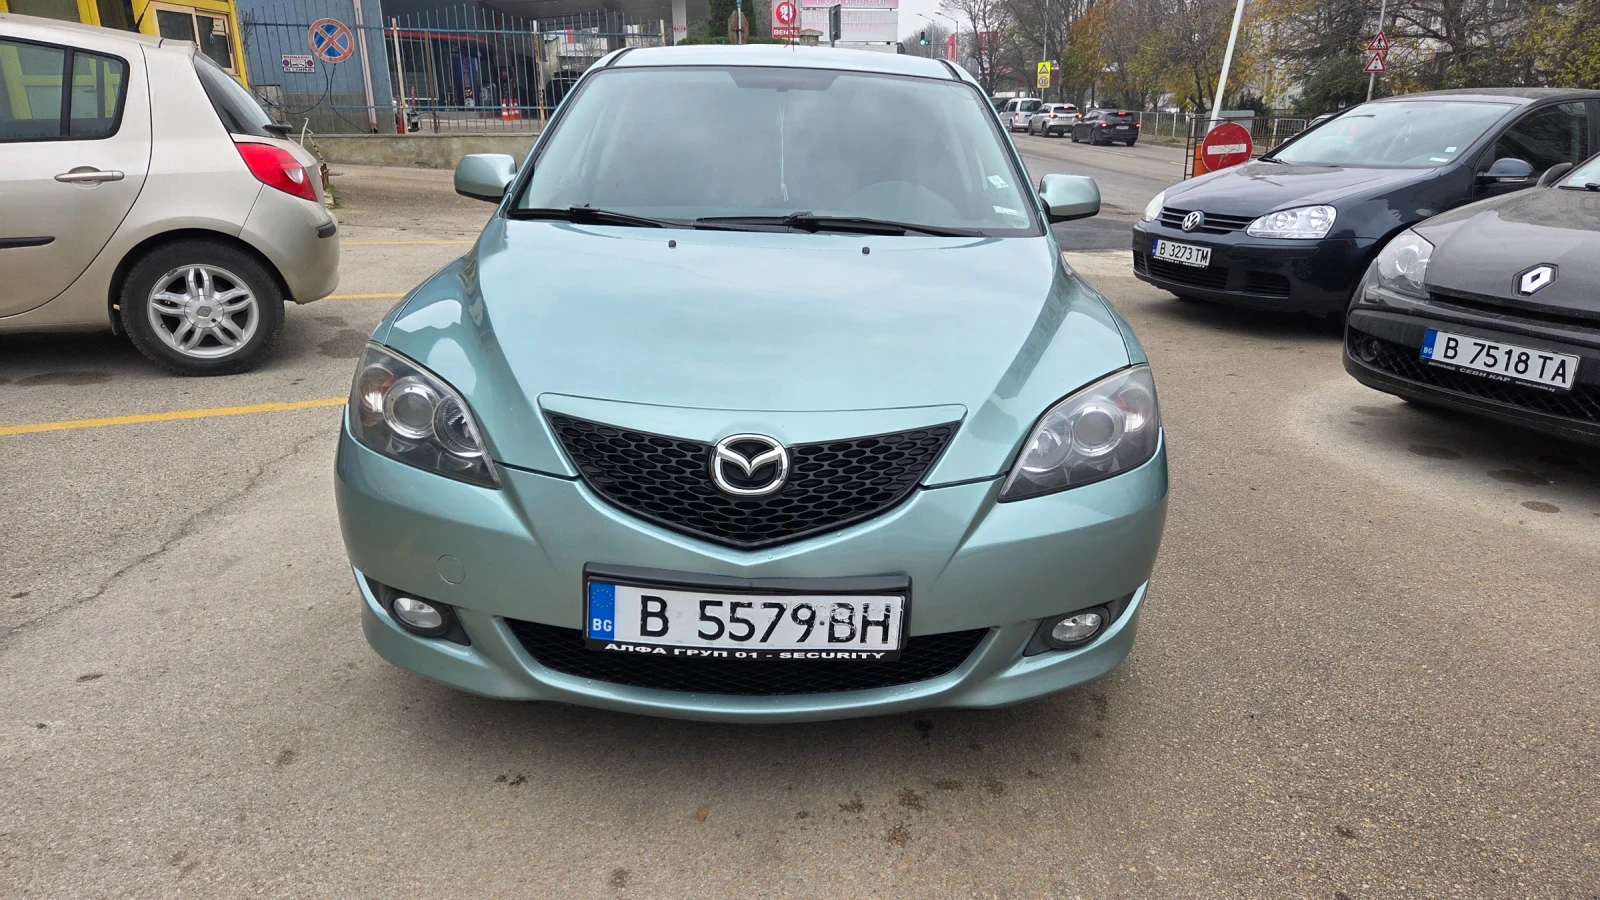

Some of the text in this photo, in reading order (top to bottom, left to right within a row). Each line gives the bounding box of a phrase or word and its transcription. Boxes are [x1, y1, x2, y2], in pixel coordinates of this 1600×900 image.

[1159, 242, 1166, 256] B
[1169, 244, 1192, 261] 3273
[1195, 248, 1209, 264] TM
[1423, 346, 1433, 354] BG
[1443, 337, 1567, 384] B 7518 TA
[1459, 367, 1487, 378] СЕВИ
[1489, 374, 1511, 382] КАР
[592, 618, 612, 632] BG
[639, 594, 891, 645] B 5579 BH
[604, 643, 667, 654] АЛФА
[673, 648, 728, 658] ГРУП
[735, 651, 758, 659] 01
[779, 651, 886, 660] SECURITY
